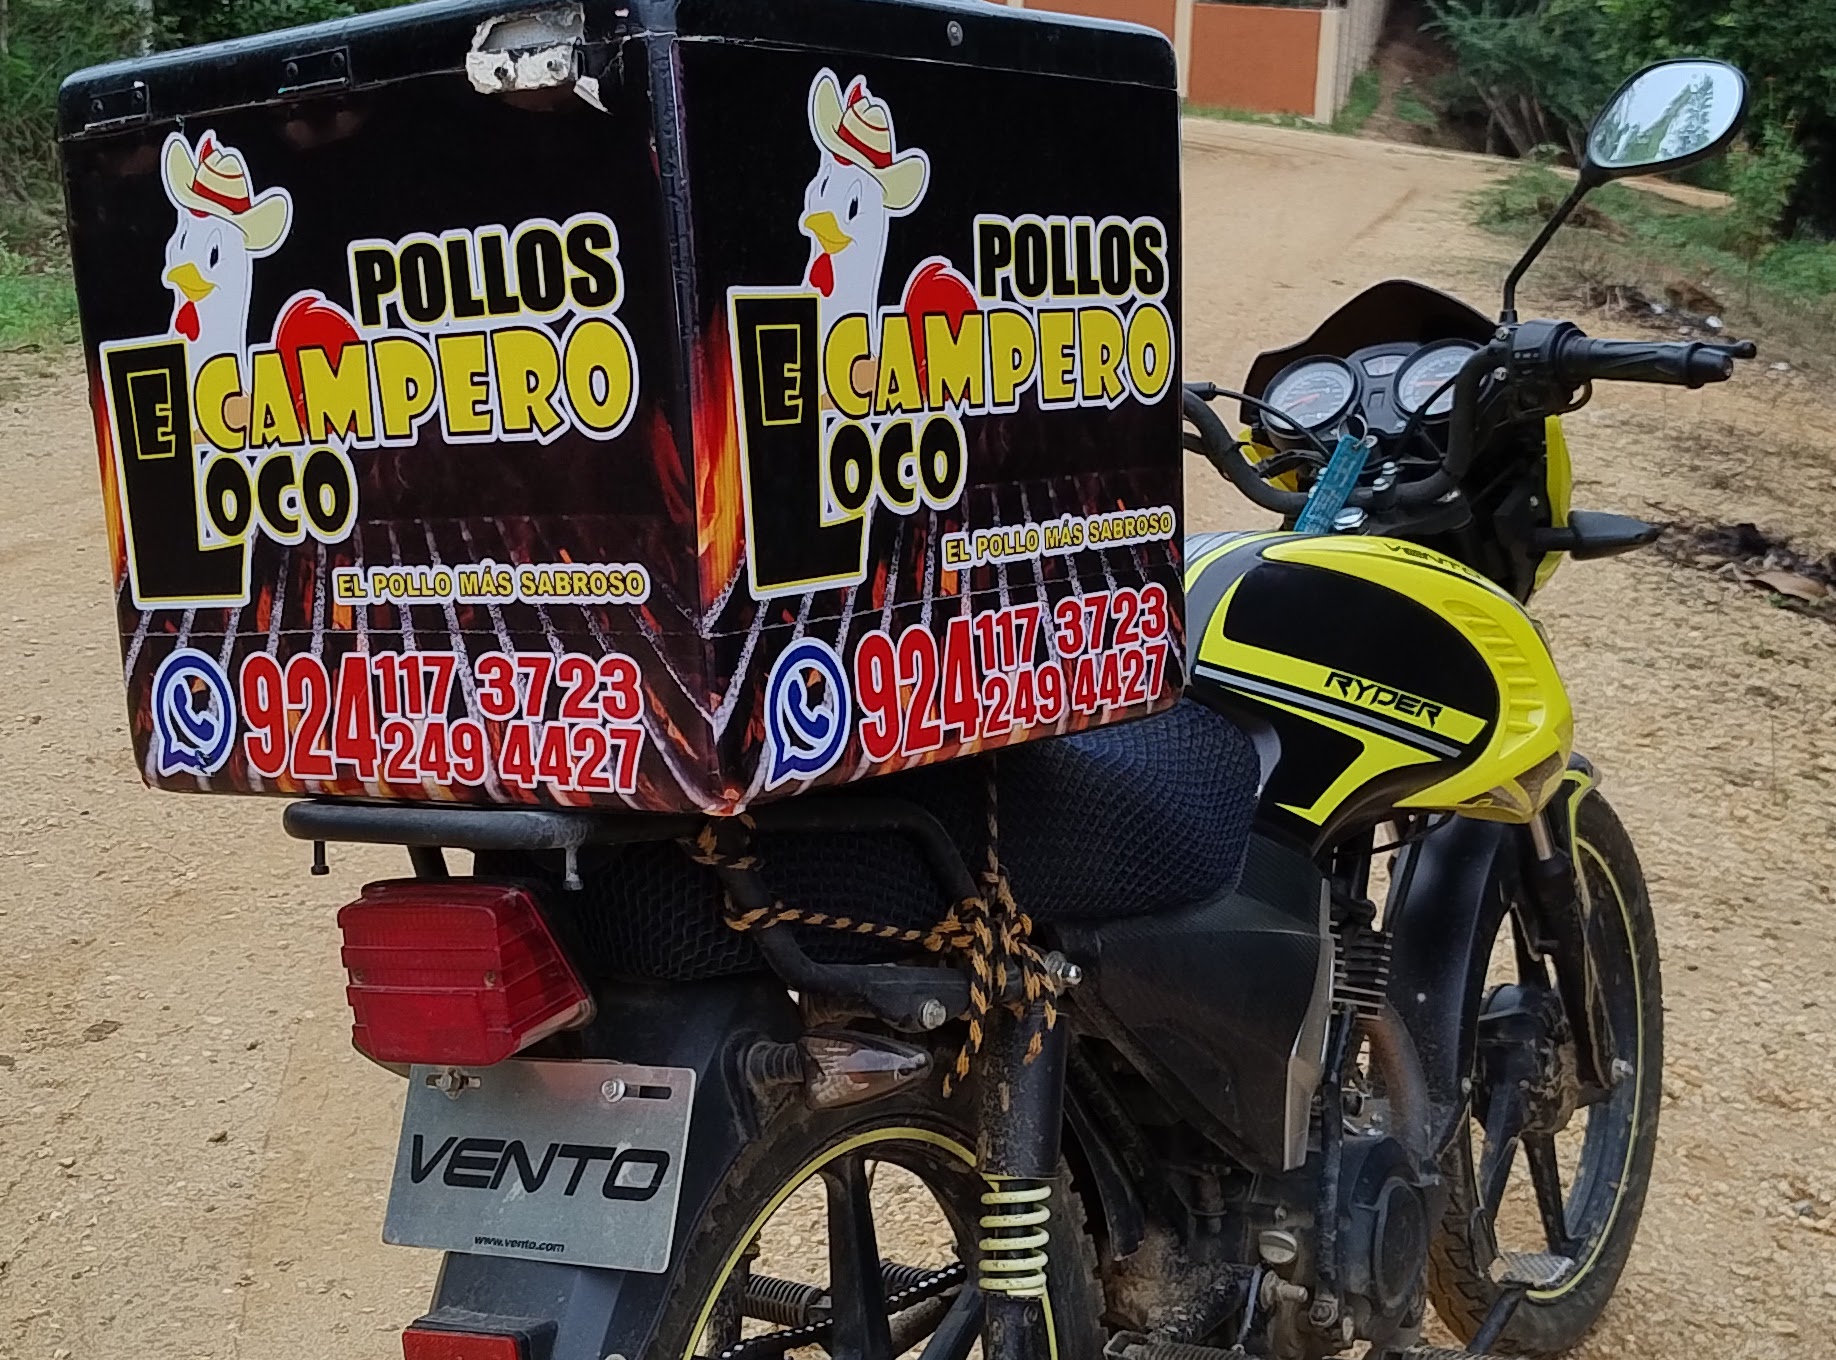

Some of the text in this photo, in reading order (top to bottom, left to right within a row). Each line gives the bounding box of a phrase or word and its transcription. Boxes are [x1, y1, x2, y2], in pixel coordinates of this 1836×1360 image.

[354, 220, 620, 330] POLLOS
[977, 220, 1165, 301] POLLOS
[194, 317, 633, 451] CAMPERO
[823, 304, 1172, 417] CAMPERO
[945, 511, 1173, 564] EL POLLO MÁS SABROSO
[337, 565, 646, 598] EL POLLO MÁS SABROSO
[857, 586, 1168, 759] 924 117 3723
[984, 643, 1168, 733] 249 4427
[1323, 671, 1443, 728] RYDER
[242, 654, 641, 779] 924 117 3723
[383, 721, 643, 791] 249 4427
[411, 1134, 671, 1202] VENTO
[474, 1236, 565, 1253] www.vento.com
